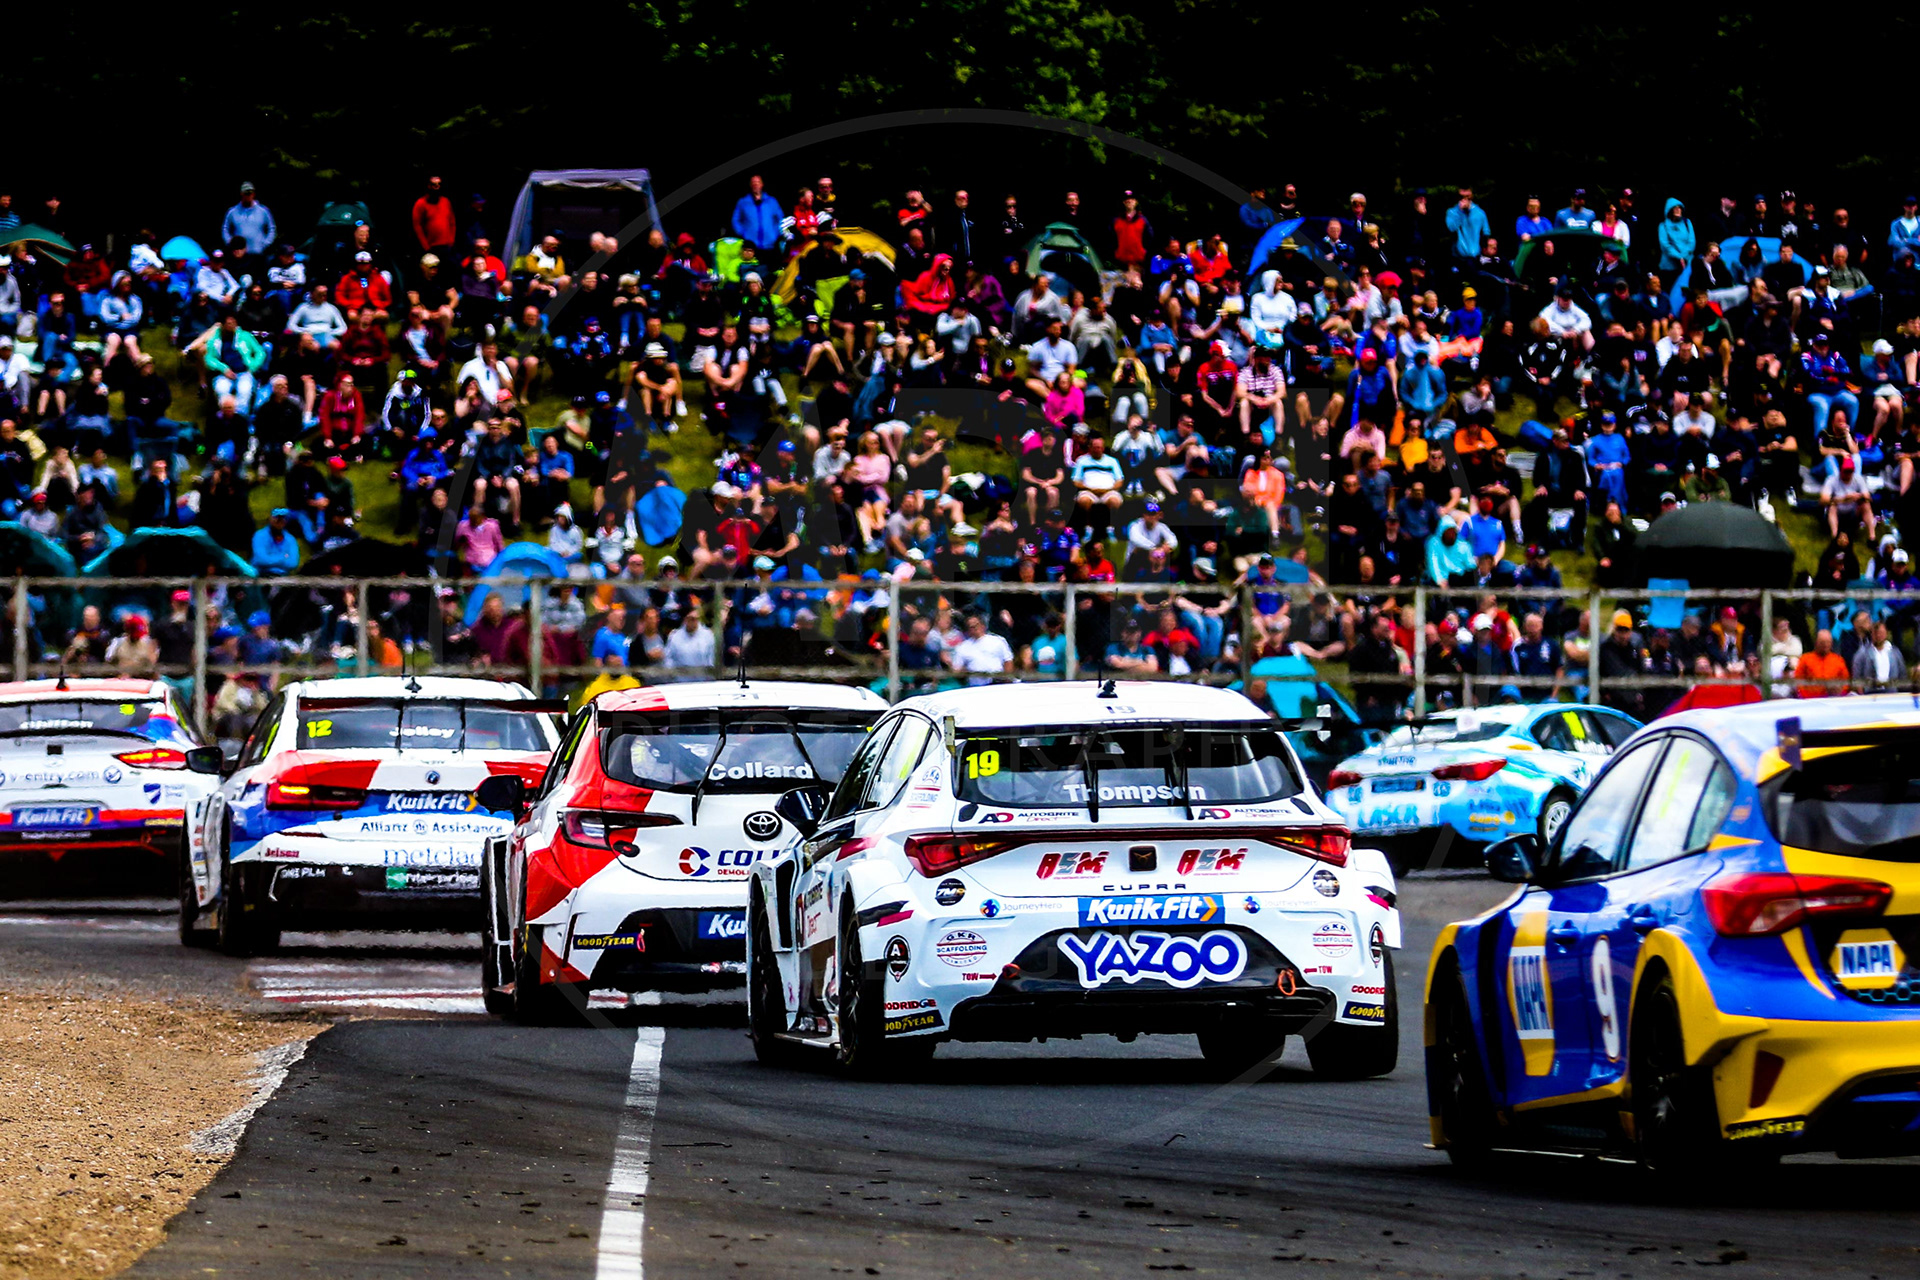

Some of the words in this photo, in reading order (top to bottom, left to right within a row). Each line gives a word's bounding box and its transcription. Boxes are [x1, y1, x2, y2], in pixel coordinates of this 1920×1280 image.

[306, 719, 333, 738] 12
[705, 761, 814, 780] Collard
[966, 749, 1000, 779] 19
[385, 792, 468, 811] KwikFit
[1063, 783, 1207, 802] Thompson
[360, 822, 408, 832] Allianz
[432, 822, 503, 833] Assistance
[1036, 851, 1109, 880] ASM
[1177, 848, 1249, 876] ASM
[1103, 883, 1187, 892] CUPRA
[1086, 895, 1204, 924] KwikFit
[577, 936, 635, 948] GOODYEAR
[946, 932, 976, 941] GKR
[937, 945, 988, 953] SCAFFOLDING
[1062, 932, 1242, 983] YAZOO
[1842, 944, 1893, 974] NAPA
